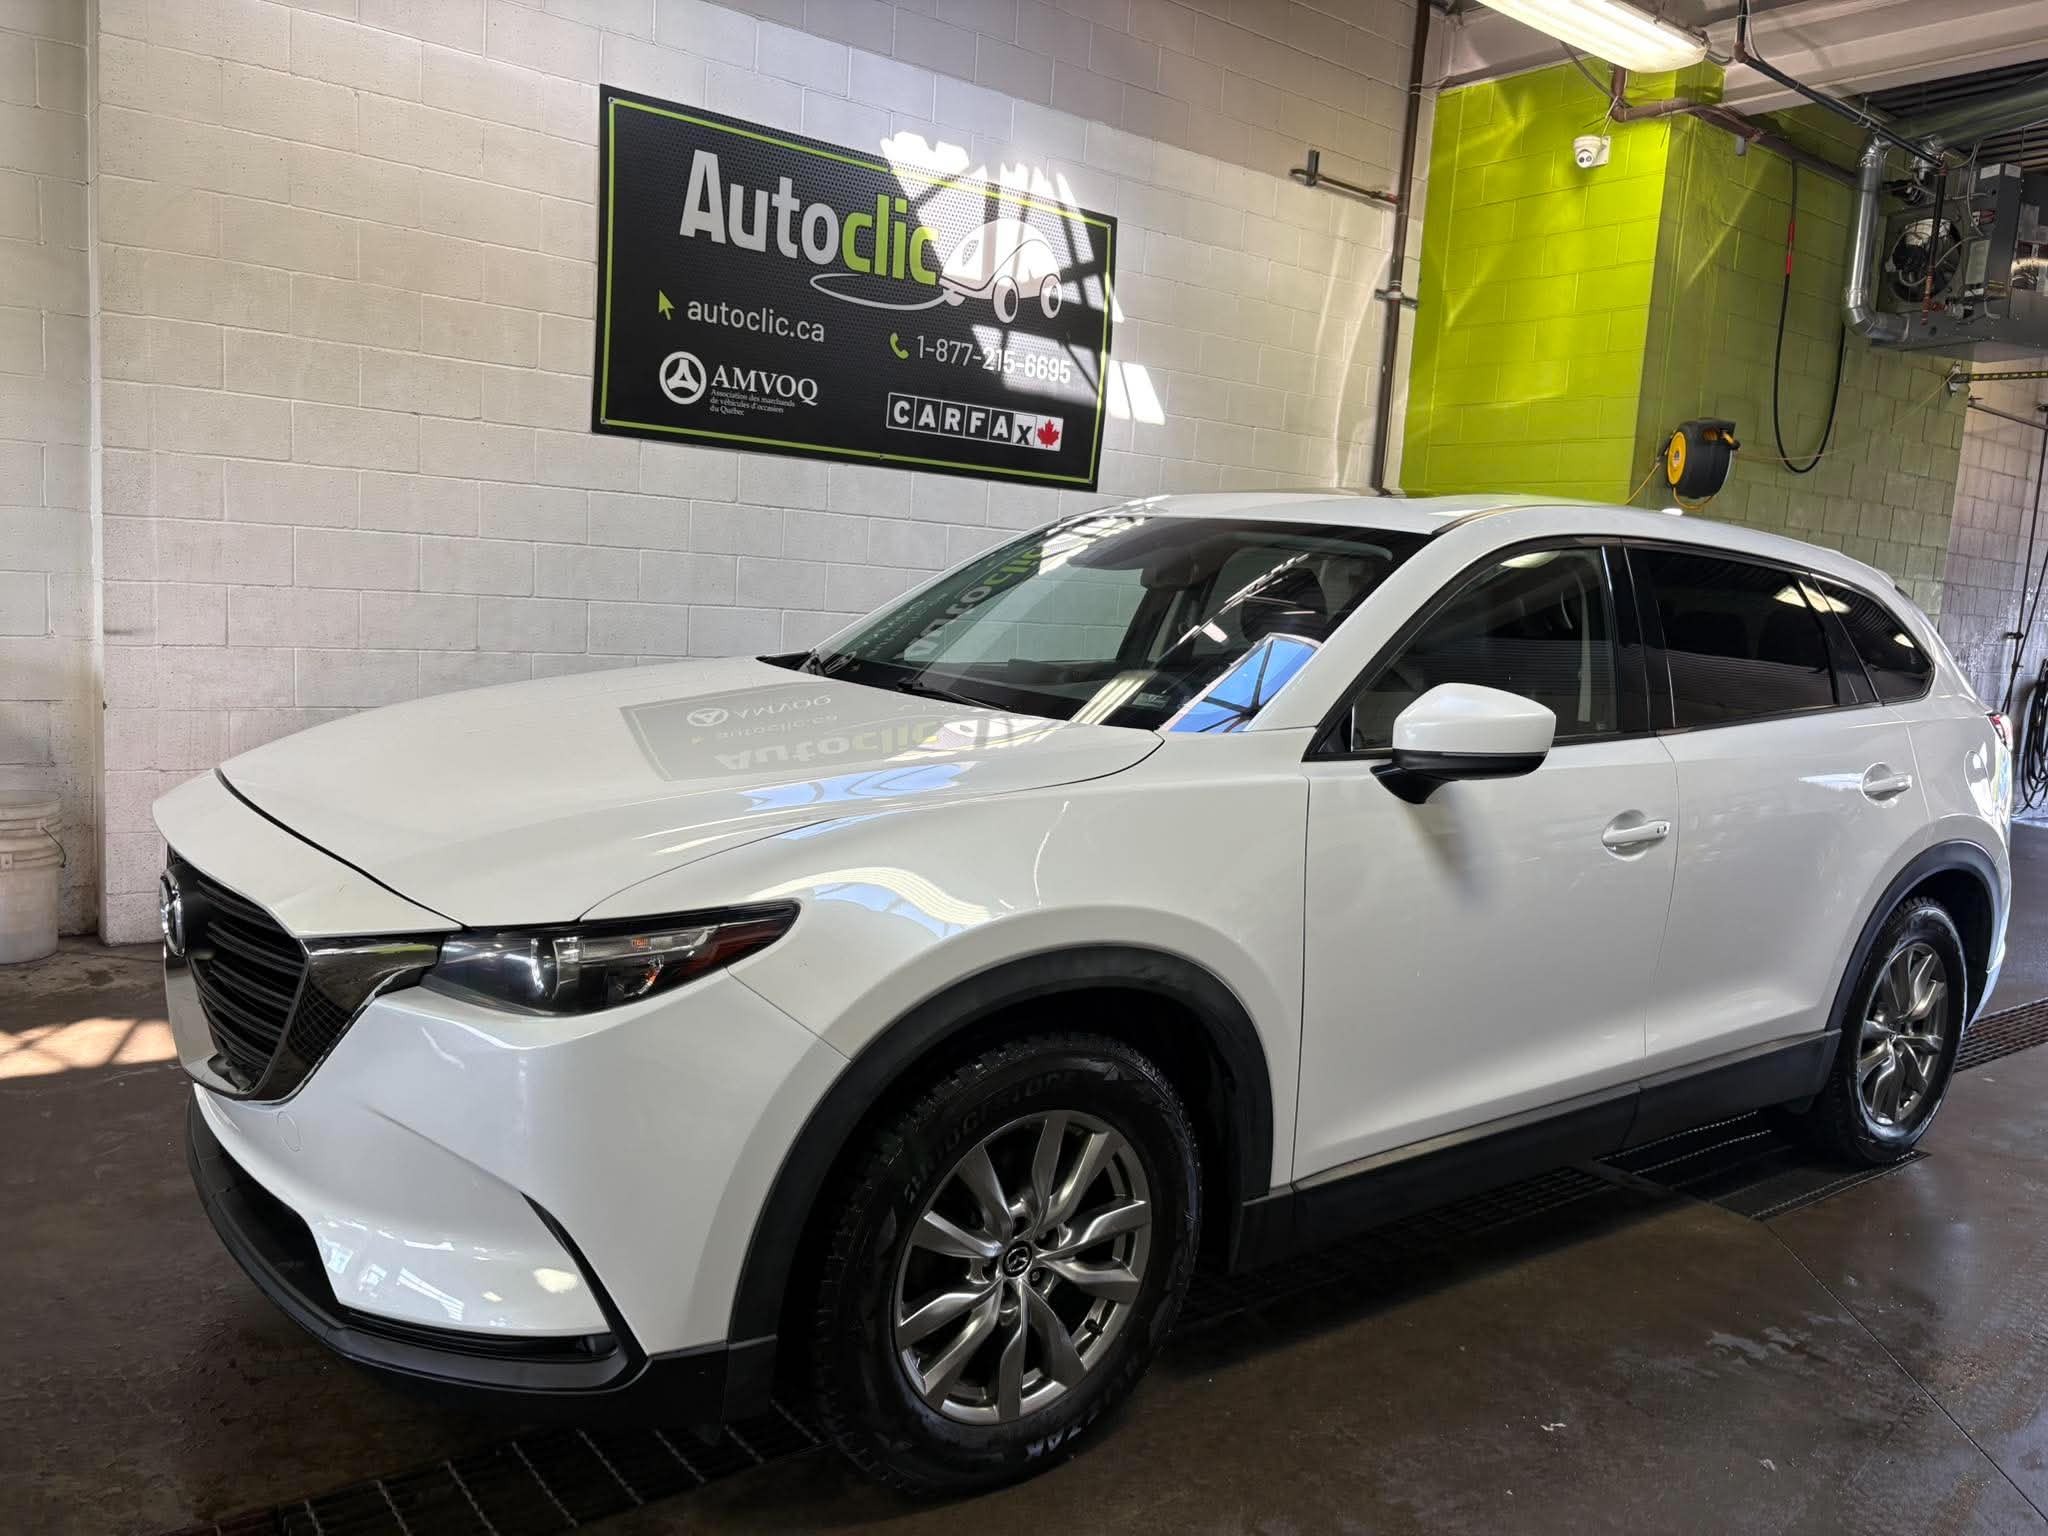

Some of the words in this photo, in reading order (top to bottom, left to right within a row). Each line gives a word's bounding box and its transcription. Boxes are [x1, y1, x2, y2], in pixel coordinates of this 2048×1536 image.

[679, 149, 939, 286] Autoclic
[687, 300, 825, 343] autoclic.ca
[916, 335, 1072, 384] 1-877-215-6695
[710, 396, 719, 404] de
[719, 398, 750, 409] véhicules
[711, 365, 819, 406] AMVOQ
[711, 389, 748, 401] Association
[749, 393, 760, 402] des
[760, 397, 796, 408] marchands
[710, 405, 719, 413] du
[720, 405, 745, 416] Québec
[893, 401, 1033, 446] CARFAX
